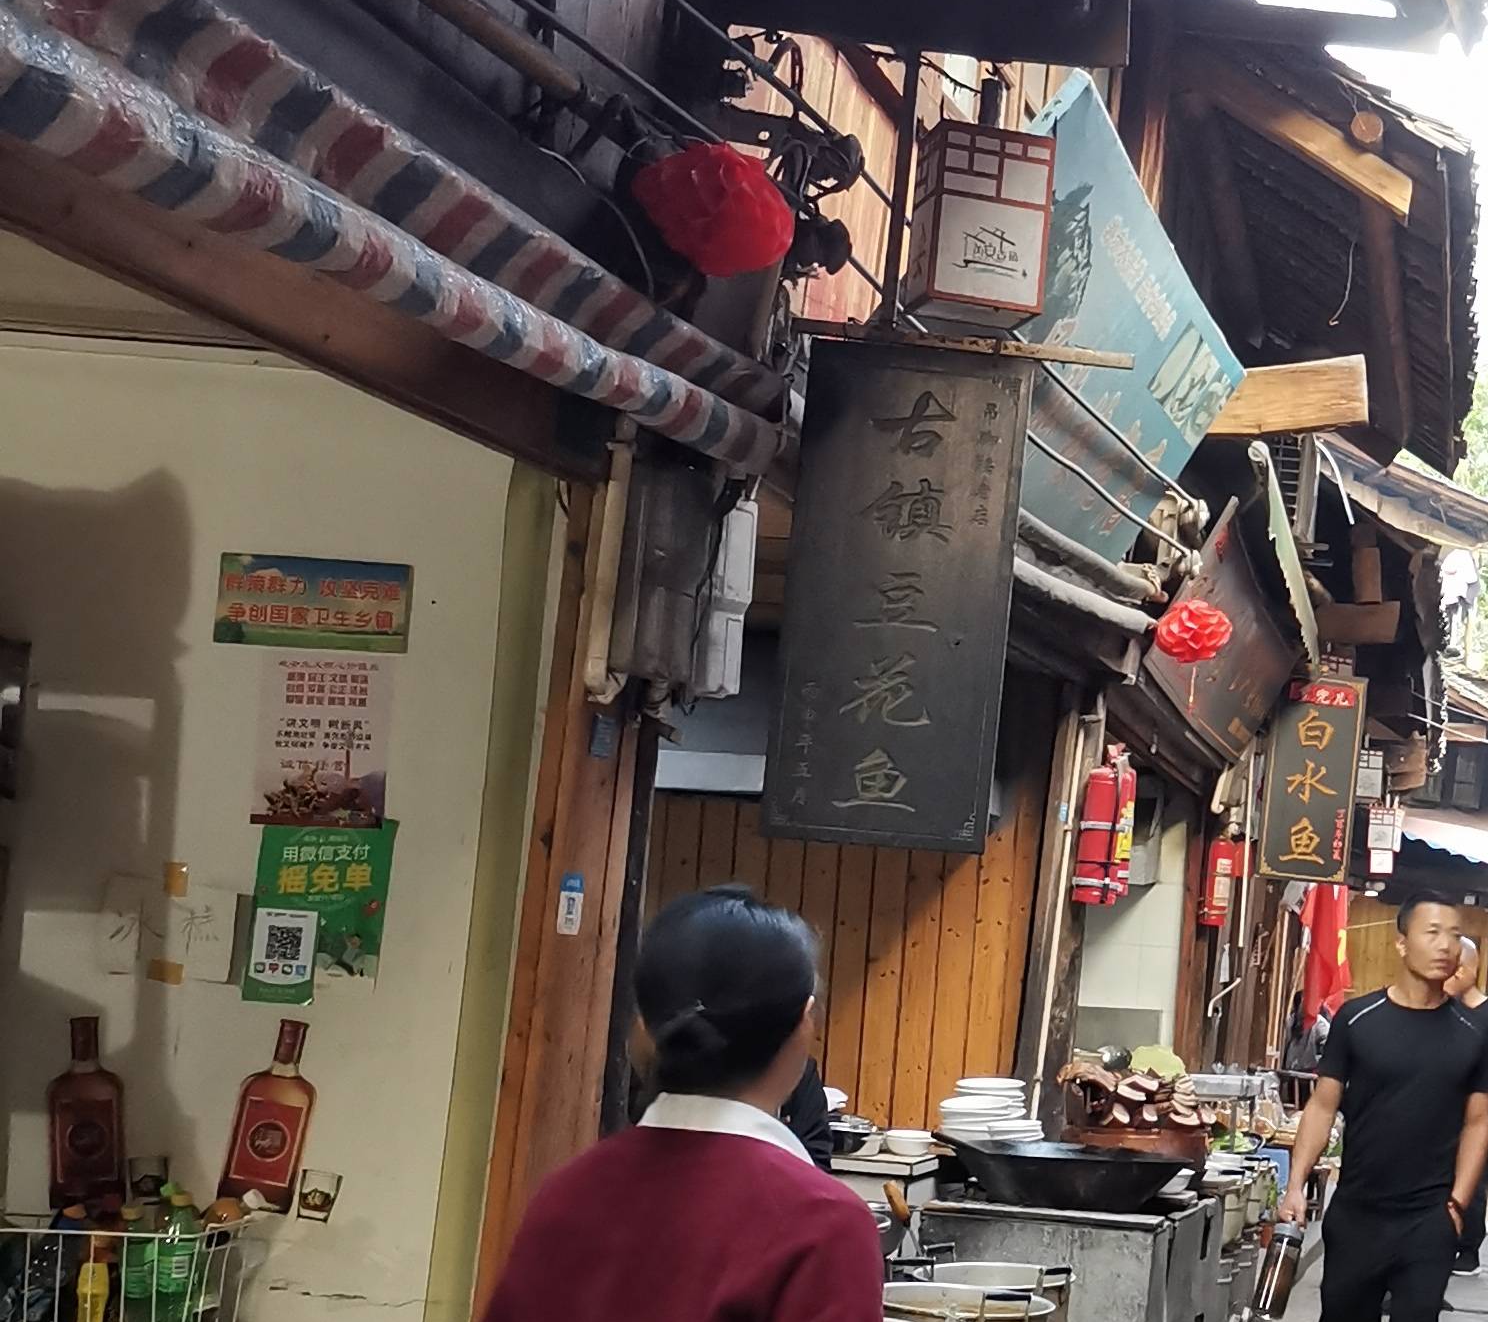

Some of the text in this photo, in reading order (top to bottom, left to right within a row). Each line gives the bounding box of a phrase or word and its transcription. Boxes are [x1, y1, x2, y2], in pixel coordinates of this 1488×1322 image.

[224, 574, 401, 602] 群策群力 攻坚克难
[832, 389, 957, 813] 古镇豆花鱼
[228, 603, 394, 630] 争创国家卫生乡镇
[1278, 709, 1338, 865] 白水鱼
[282, 844, 371, 863] 用微信支付
[277, 862, 373, 894] 摇免单
